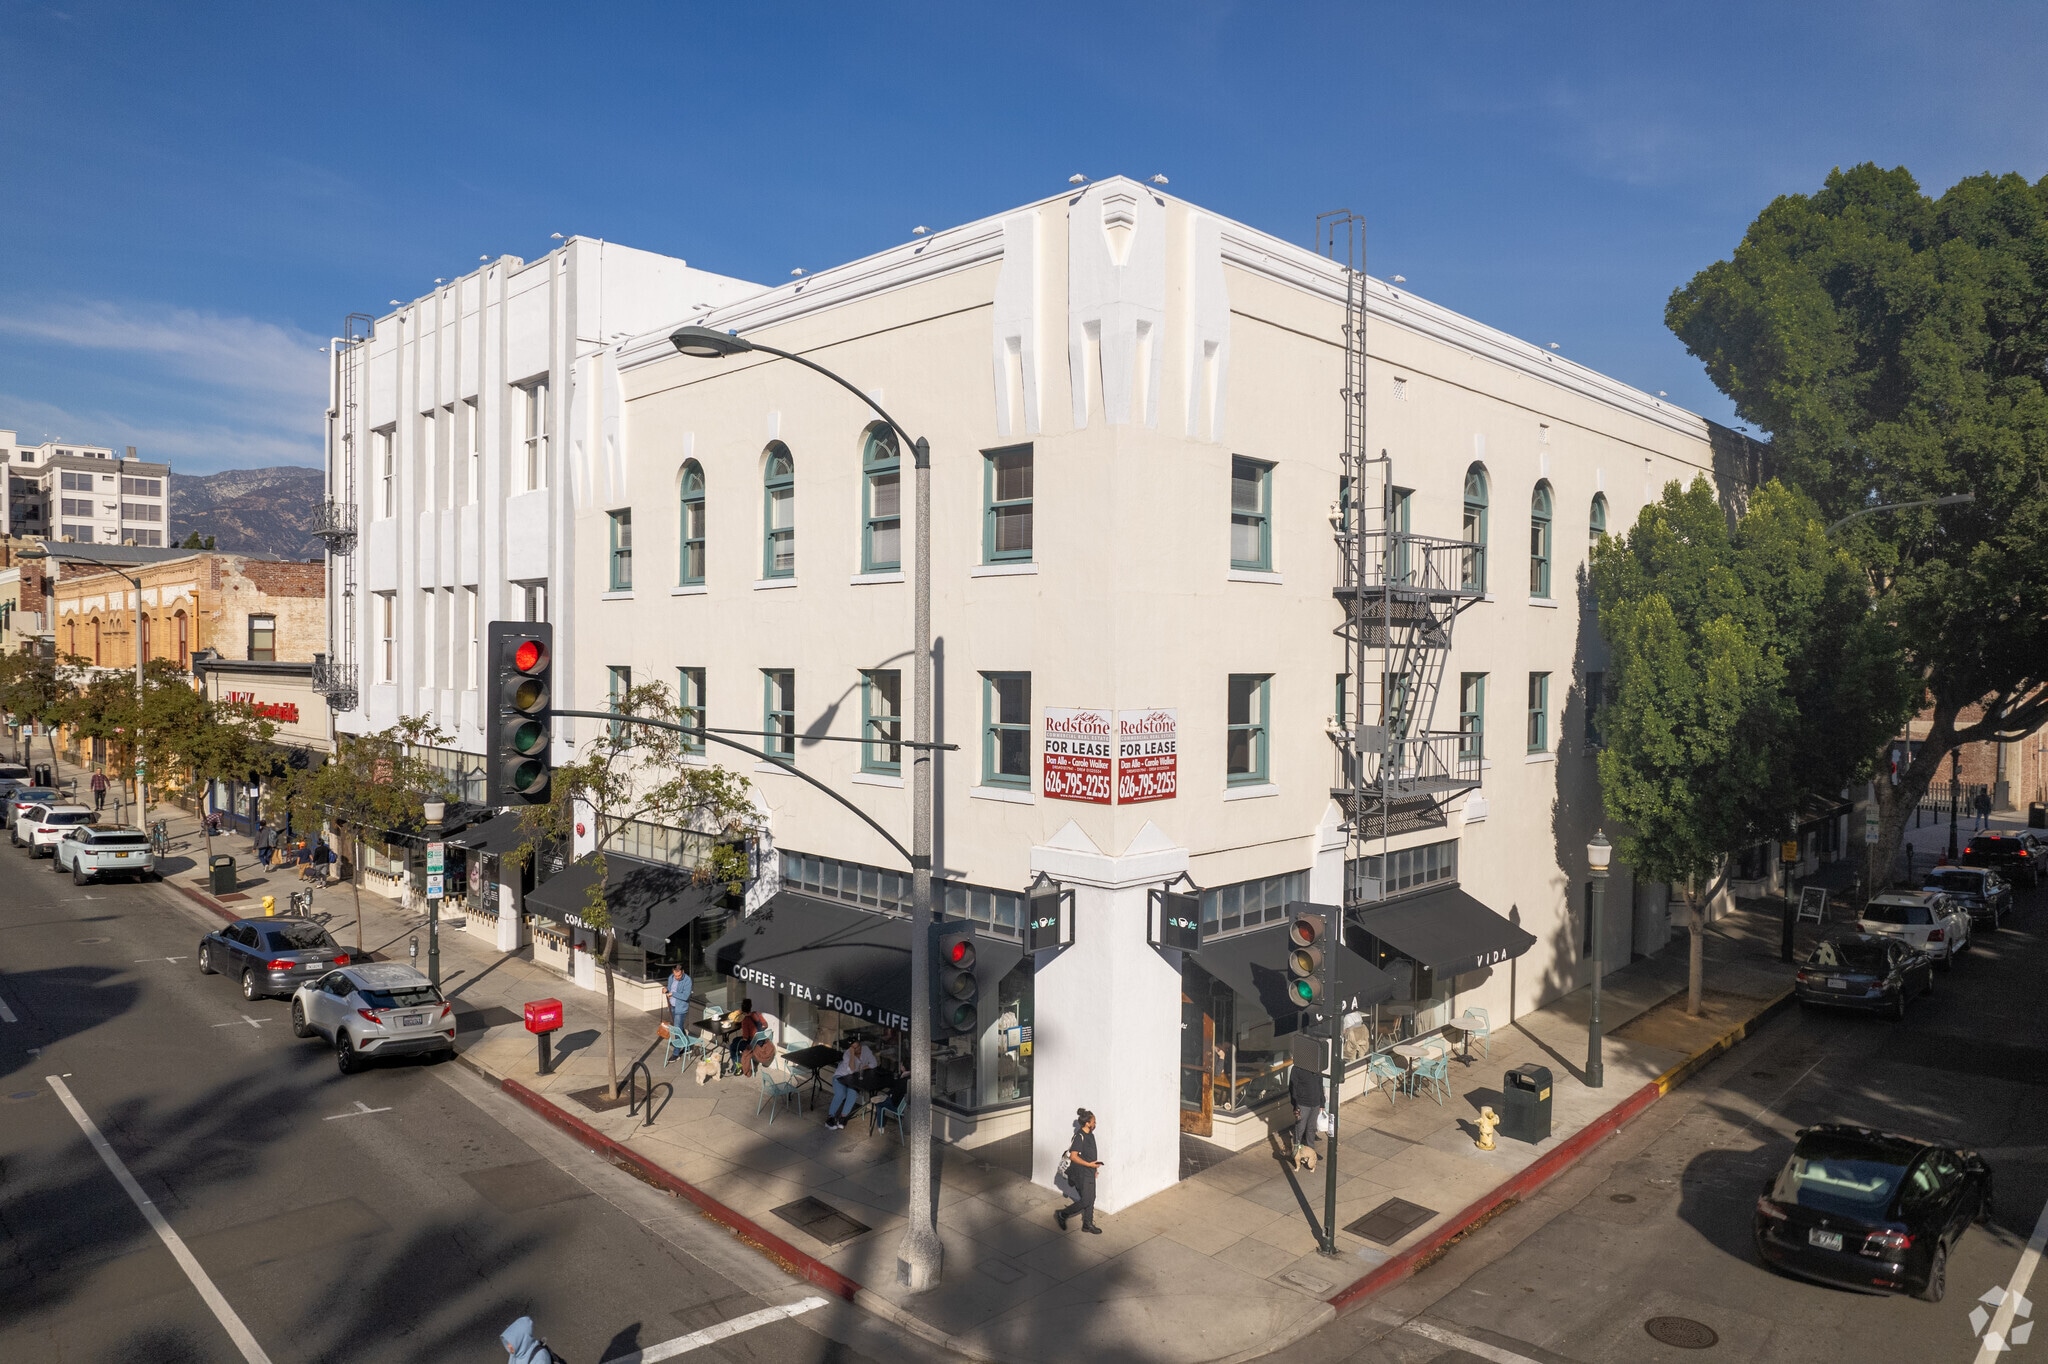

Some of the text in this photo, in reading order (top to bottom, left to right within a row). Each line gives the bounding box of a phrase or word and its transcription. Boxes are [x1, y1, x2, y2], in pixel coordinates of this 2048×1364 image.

[1046, 717, 1110, 735] Redstone
[1120, 718, 1176, 735] Redstone
[1045, 740, 1110, 757] FOR LEASE
[1120, 741, 1176, 756] FOR LEASE
[1046, 755, 1057, 765] Dan
[1071, 757, 1089, 768] Carole
[1089, 758, 1109, 770] Walker
[1120, 760, 1131, 769] Dan
[1144, 757, 1160, 767] Carole
[1159, 756, 1176, 766] Walker
[1045, 770, 1110, 799] 626-795-2255
[1119, 771, 1176, 798] 626-795-2255
[564, 913, 583, 928] COPA
[1477, 948, 1507, 967] VIDA
[733, 964, 909, 1032] COFFEE TEA FOOD LIFE
